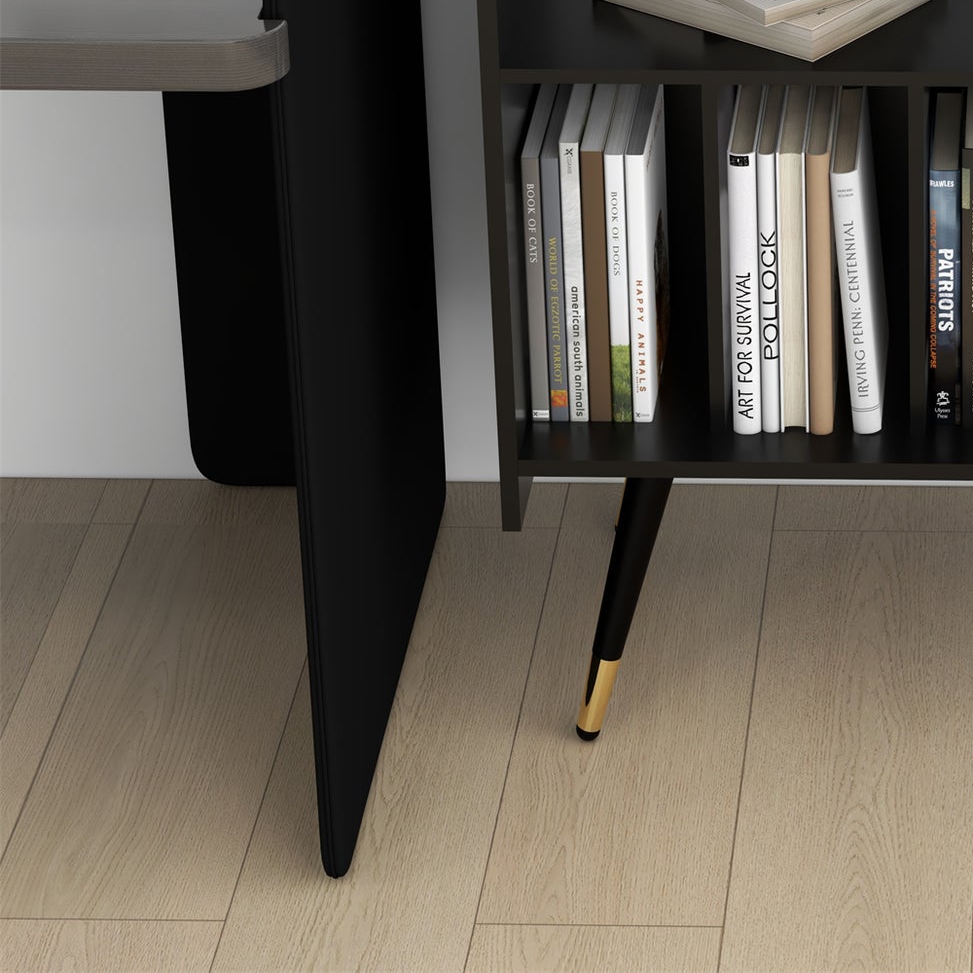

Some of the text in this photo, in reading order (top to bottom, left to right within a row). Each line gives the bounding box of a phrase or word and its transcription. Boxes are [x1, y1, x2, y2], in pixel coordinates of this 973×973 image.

[526, 183, 538, 264] BOOK OF CATS
[610, 191, 621, 276] BOOK OF DOGS
[549, 237, 562, 384] WORLD OF EGZOTIC PARROT
[636, 280, 647, 392] HAPPY ANIMALS
[735, 272, 754, 419] ART FOR SURVIVAL
[760, 231, 778, 360] POLLOCK
[842, 220, 870, 398] IRVING PENN: CENTENNIAL
[930, 292, 938, 304] THE
[938, 248, 955, 332] PATRIOTS
[570, 286, 585, 417] american south animals
